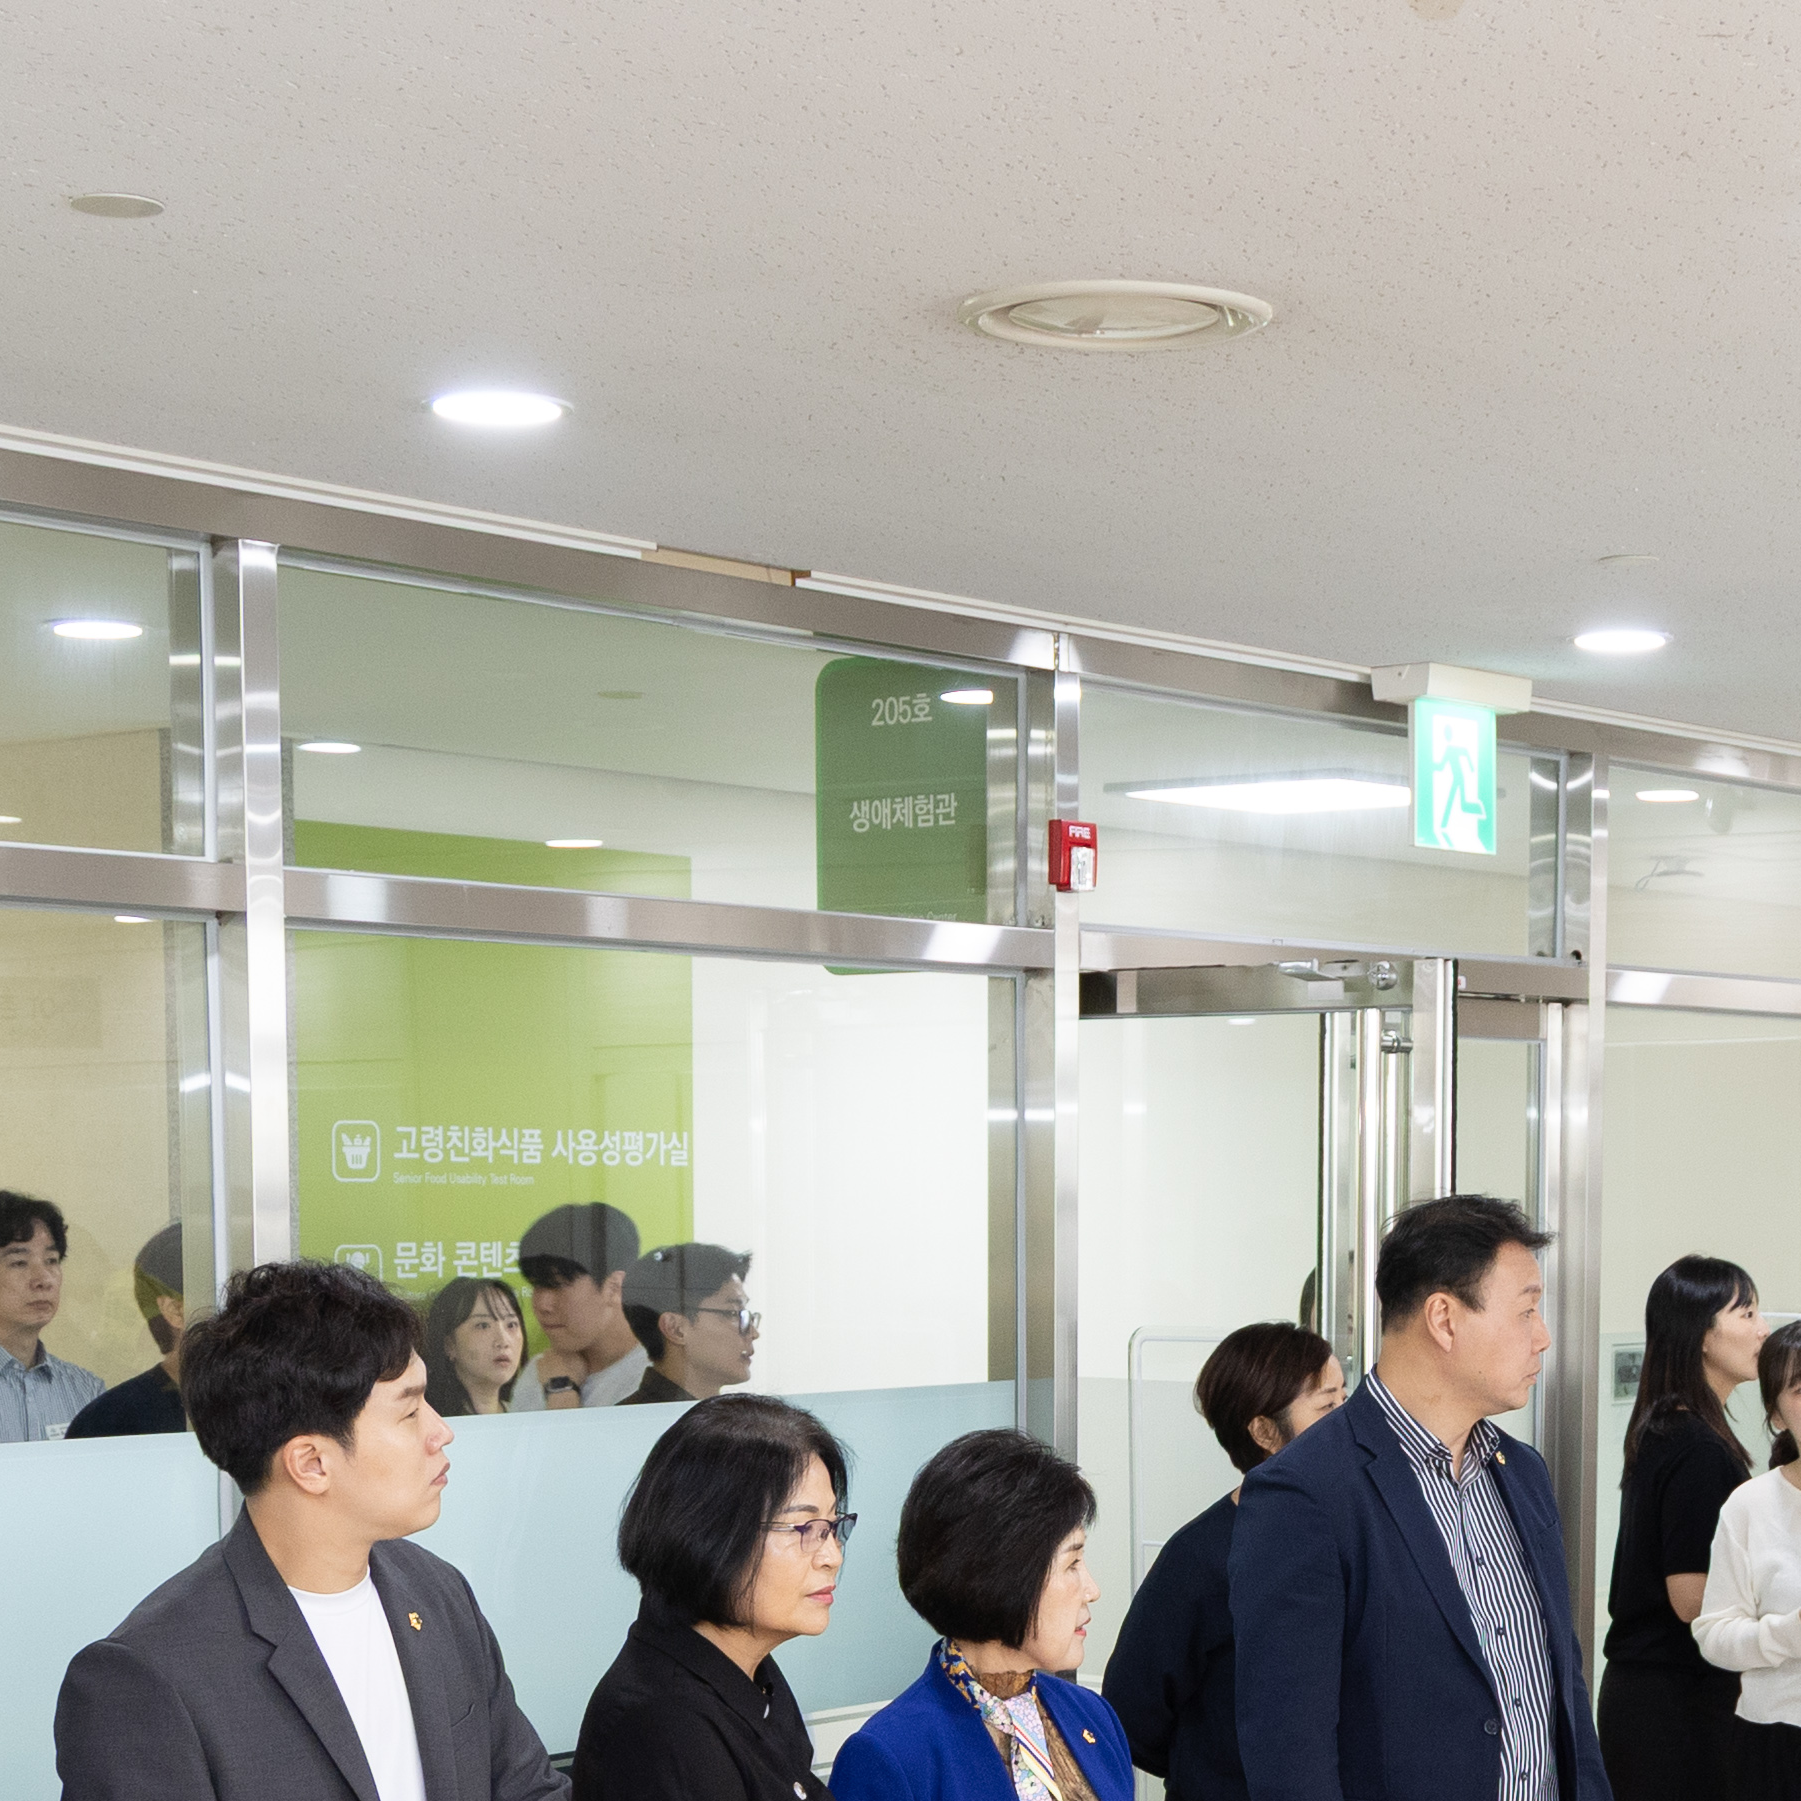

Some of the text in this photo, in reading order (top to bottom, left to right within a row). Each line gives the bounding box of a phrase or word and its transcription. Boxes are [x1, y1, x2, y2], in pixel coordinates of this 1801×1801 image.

[871, 692, 932, 726] 205호
[850, 793, 957, 833] 생애체험관
[1069, 825, 1091, 839] FIRE
[393, 1125, 689, 1167] 고령친화식품 사용성평가실
[393, 1172, 534, 1187] Senior Food Usability Test Room
[393, 1241, 446, 1278] 문화
